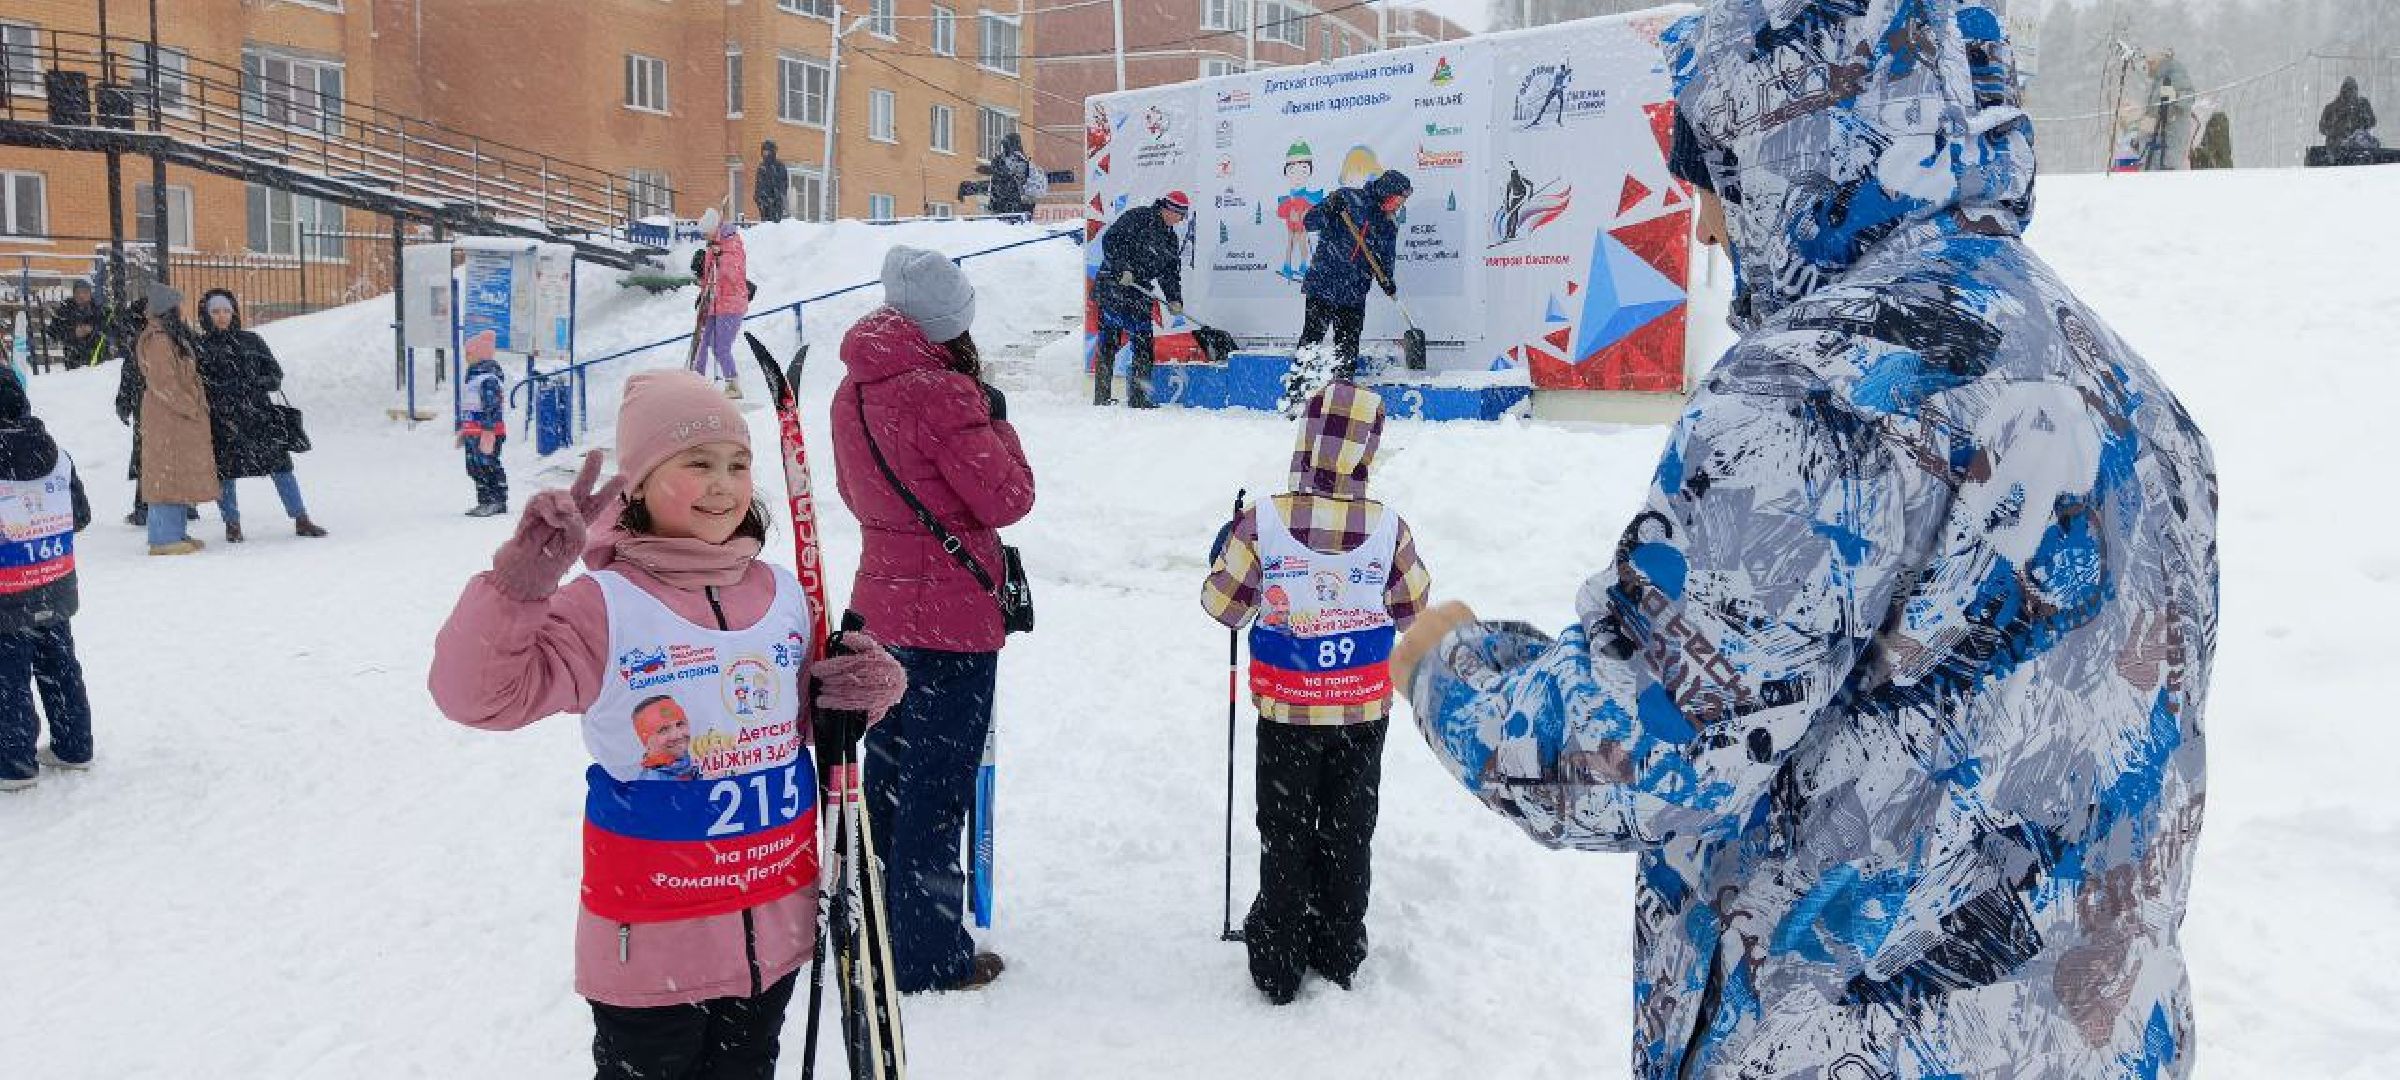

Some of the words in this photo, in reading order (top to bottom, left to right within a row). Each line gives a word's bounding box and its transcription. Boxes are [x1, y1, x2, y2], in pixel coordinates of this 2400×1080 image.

[1264, 77, 1307, 94] Детская
[1309, 68, 1377, 88] спортивная
[1380, 62, 1414, 77] гонка
[1402, 391, 1422, 421] 3
[23, 536, 64, 563] 166
[1317, 637, 1355, 668] 89
[677, 664, 719, 681] страна
[706, 767, 798, 837] 215
[715, 850, 740, 865] на
[747, 833, 795, 861] призы
[655, 872, 741, 889] Романа
